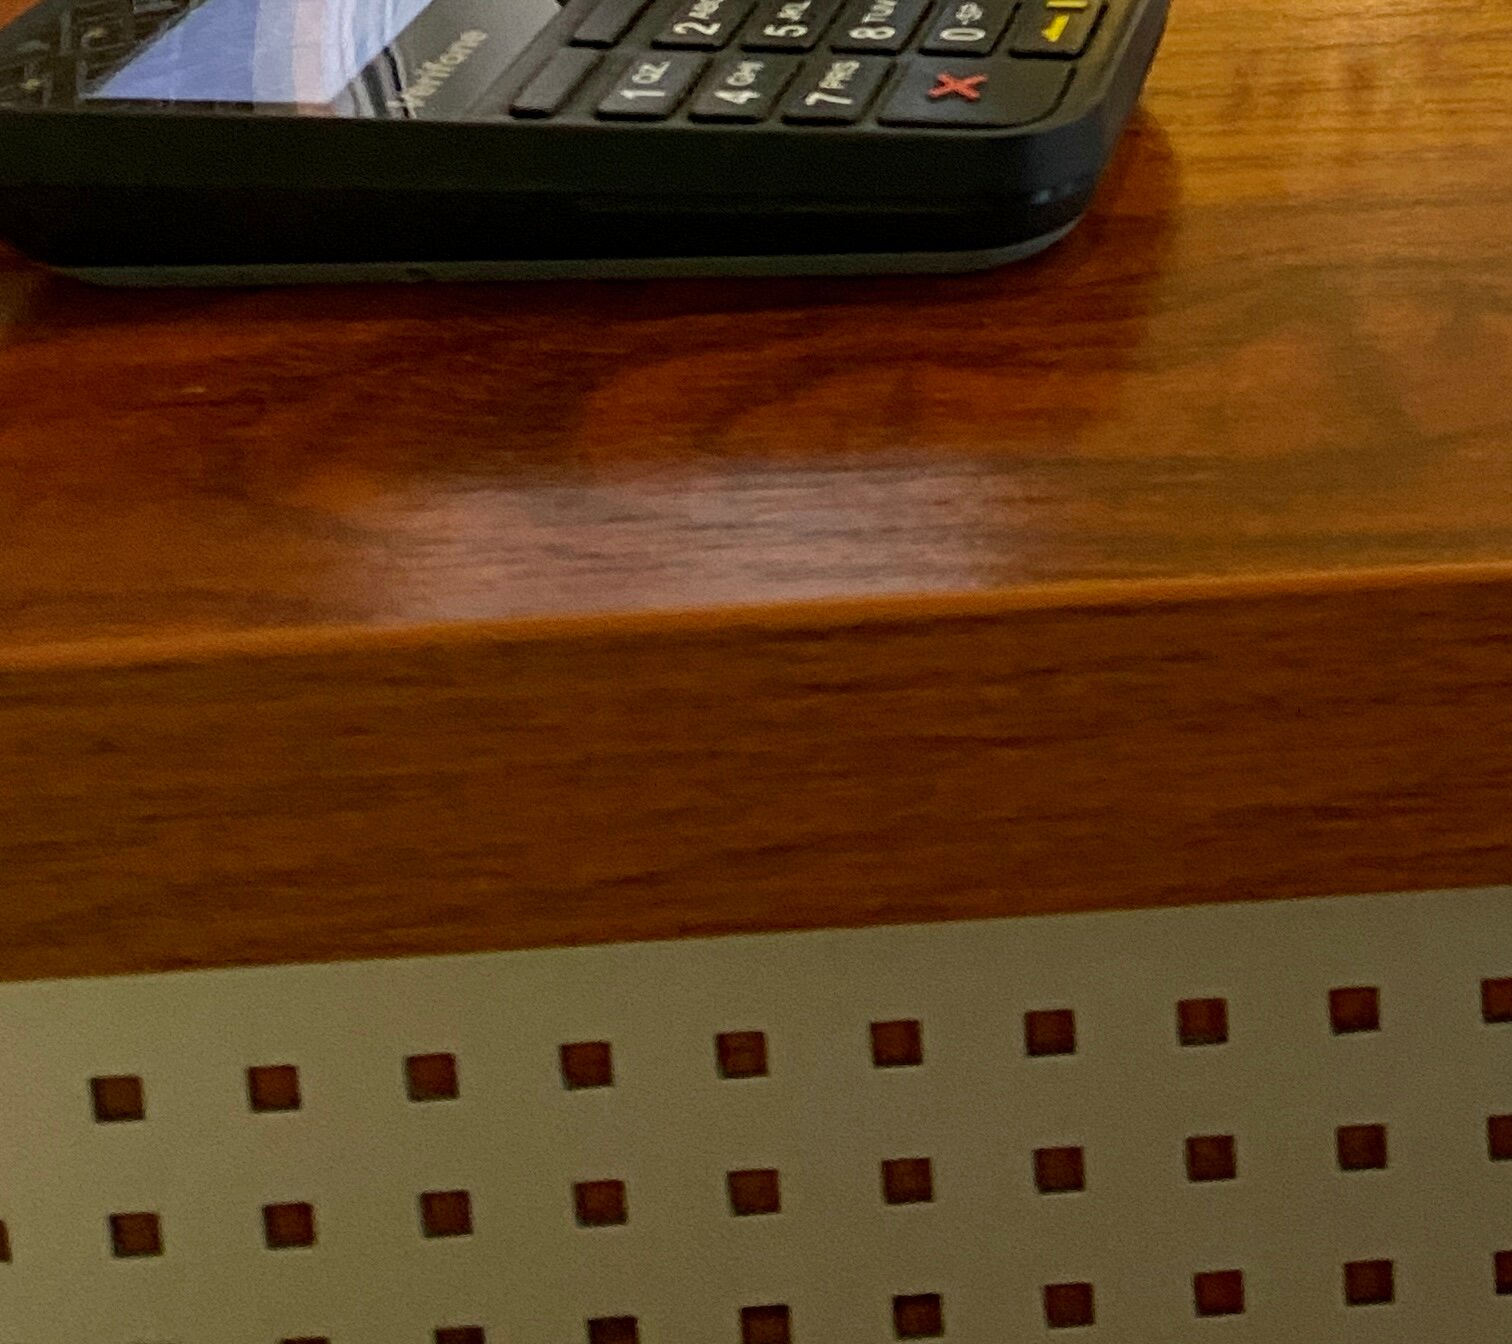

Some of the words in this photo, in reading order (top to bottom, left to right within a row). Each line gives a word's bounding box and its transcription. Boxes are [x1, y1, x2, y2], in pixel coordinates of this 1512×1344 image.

[672, 21, 722, 36] 2
[763, 23, 809, 38] 5
[848, 25, 896, 41] 8
[939, 26, 987, 42] 0
[619, 89, 666, 101] 1
[713, 89, 762, 105] 4
[804, 91, 854, 107] 7
